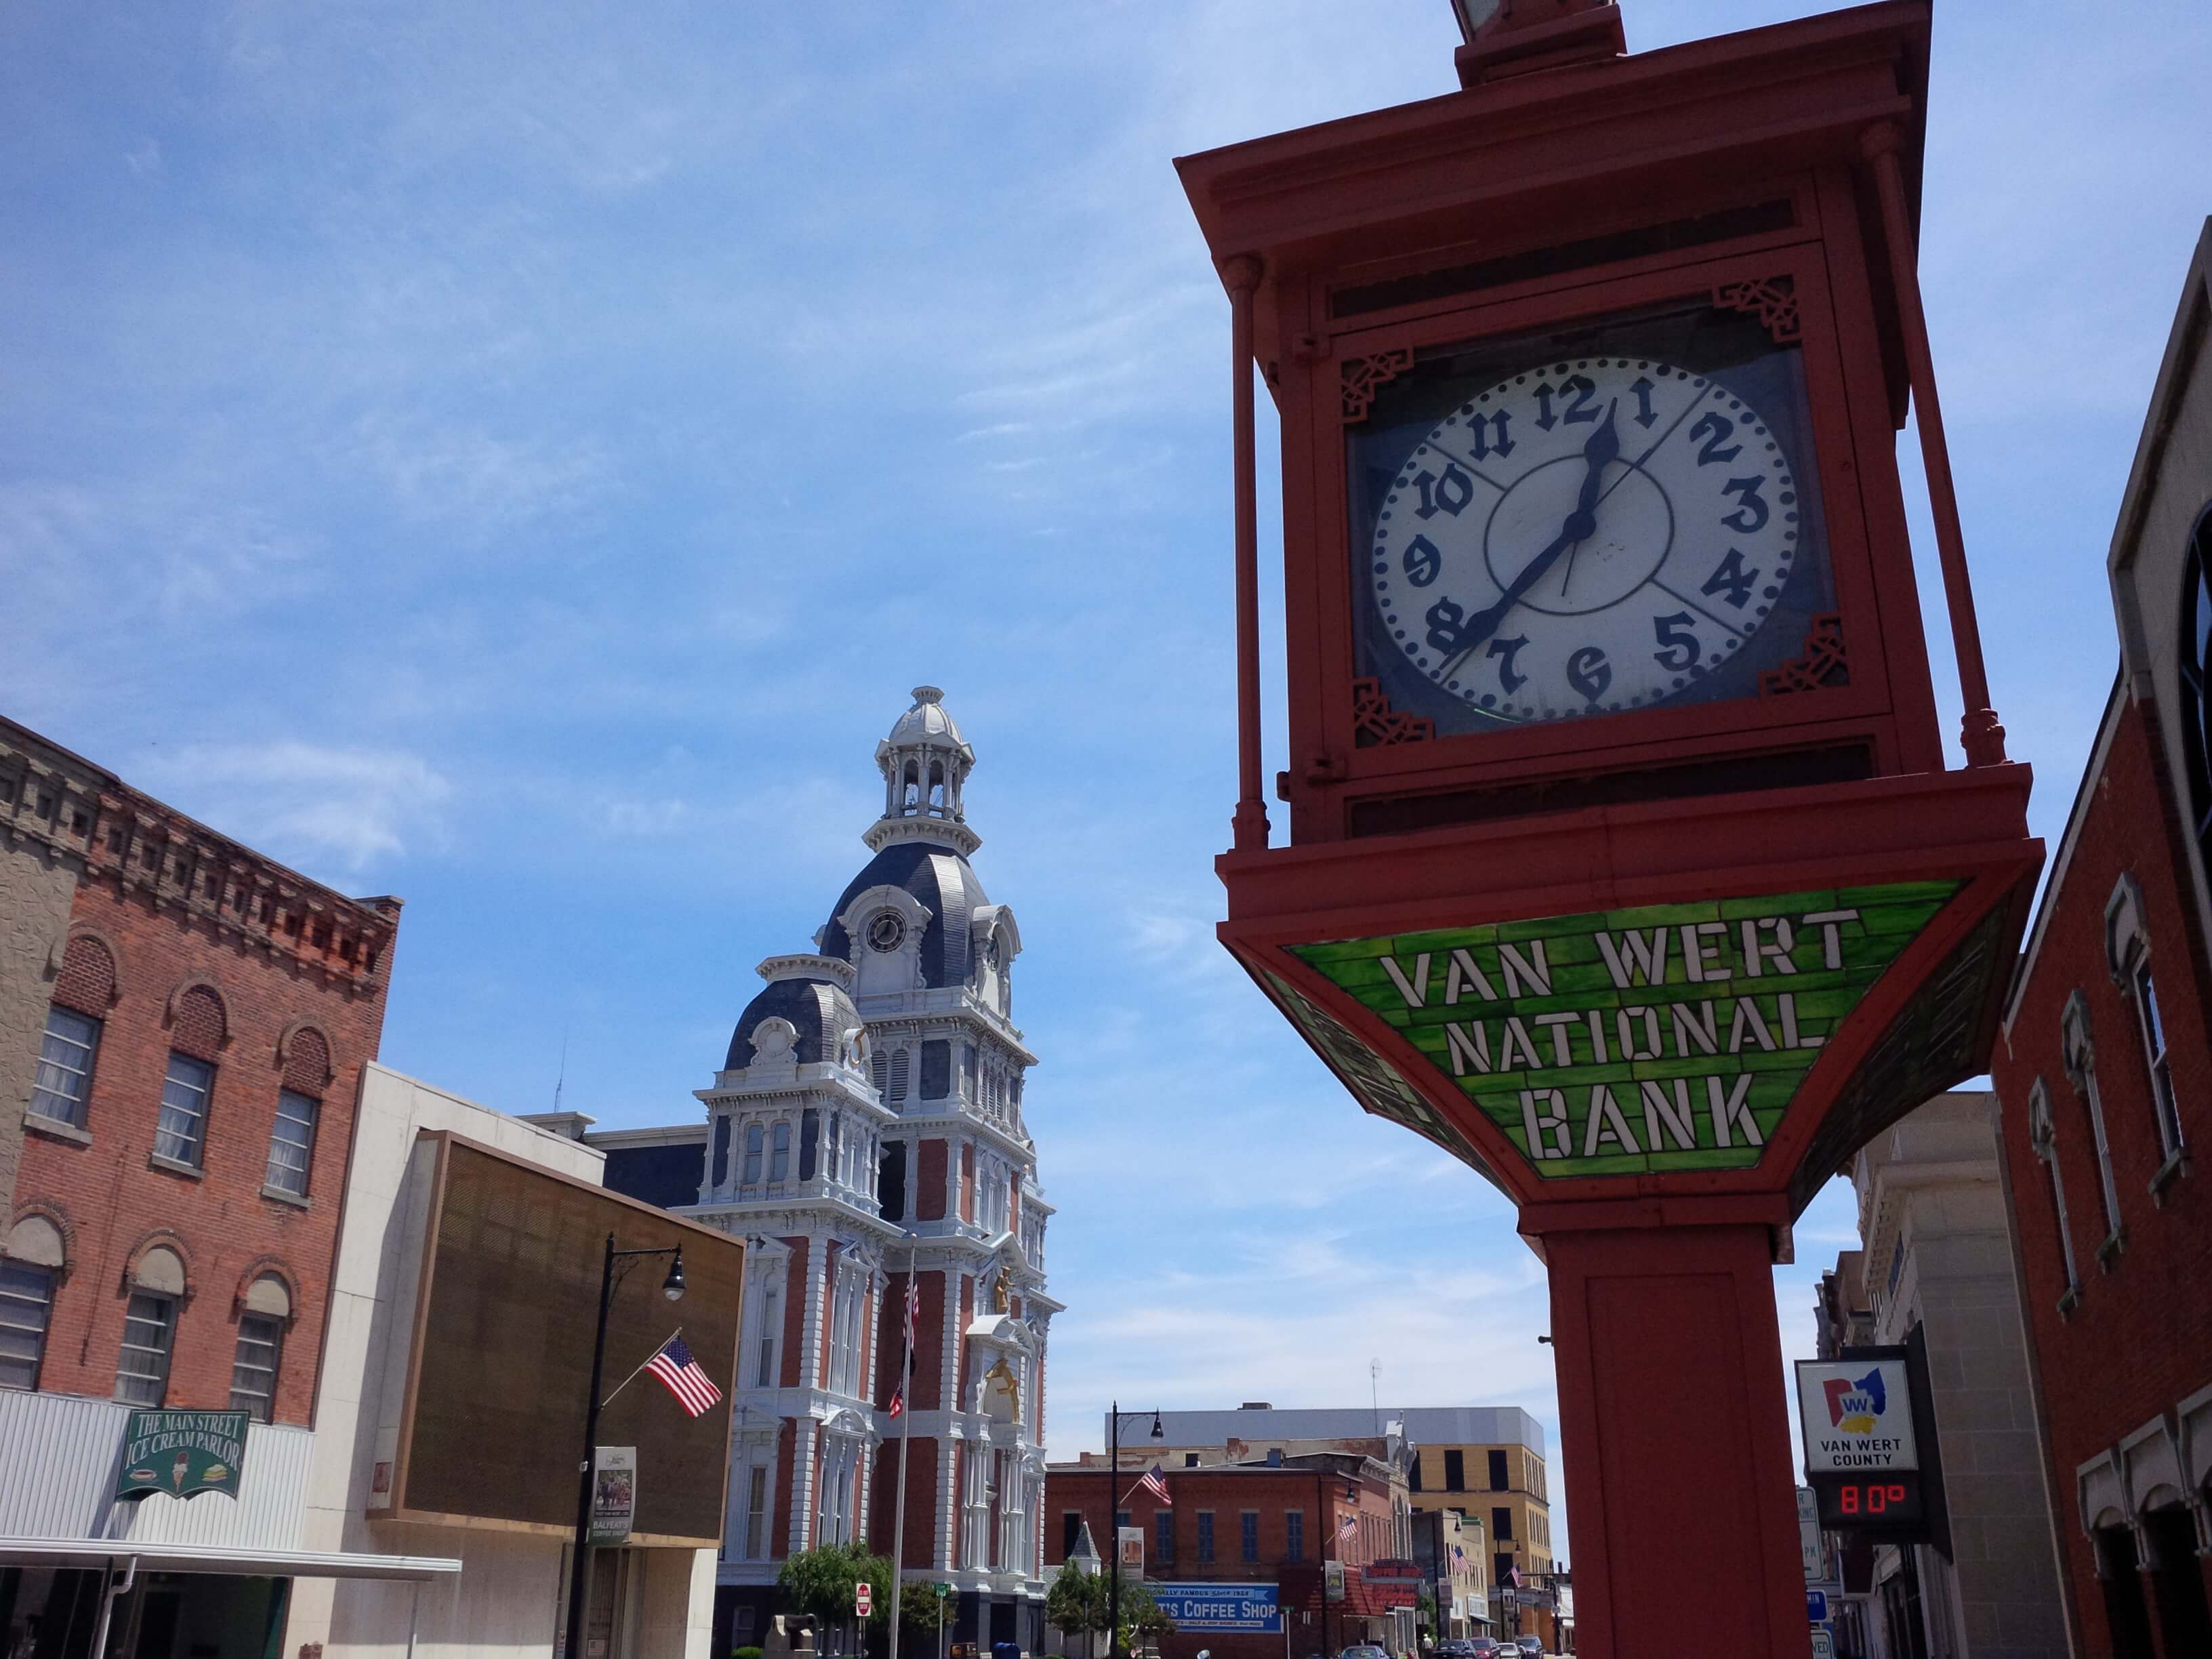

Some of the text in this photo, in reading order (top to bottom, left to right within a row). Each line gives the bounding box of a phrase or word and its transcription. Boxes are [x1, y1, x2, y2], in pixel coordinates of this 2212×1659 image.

[1534, 375, 1603, 432] 12
[1630, 376, 1659, 429] 1
[1466, 409, 1516, 462] 11
[1689, 411, 1743, 466] 2
[1412, 463, 1473, 520] 10
[1721, 475, 1769, 533] 3
[1403, 534, 1441, 588] 9
[1700, 548, 1760, 609] 4
[1425, 596, 1467, 655] 8
[1654, 611, 1701, 672] 5
[1486, 634, 1530, 695] 7
[1567, 647, 1612, 703] 6
[1380, 909, 1861, 1008] VAN WERT
[1446, 994, 1825, 1076] NATIONAL
[1520, 1073, 1763, 1160] BANK
[137, 1414, 242, 1439] THE MAIN STREET
[1843, 1398, 1868, 1412] VW
[125, 1431, 240, 1471] ICE CREAM PARLOR
[1820, 1438, 1902, 1452] VAN WERT
[1832, 1453, 1892, 1467] COUNTY
[1184, 1600, 1235, 1618] COFFEE
[1242, 1601, 1277, 1618] SHOP
